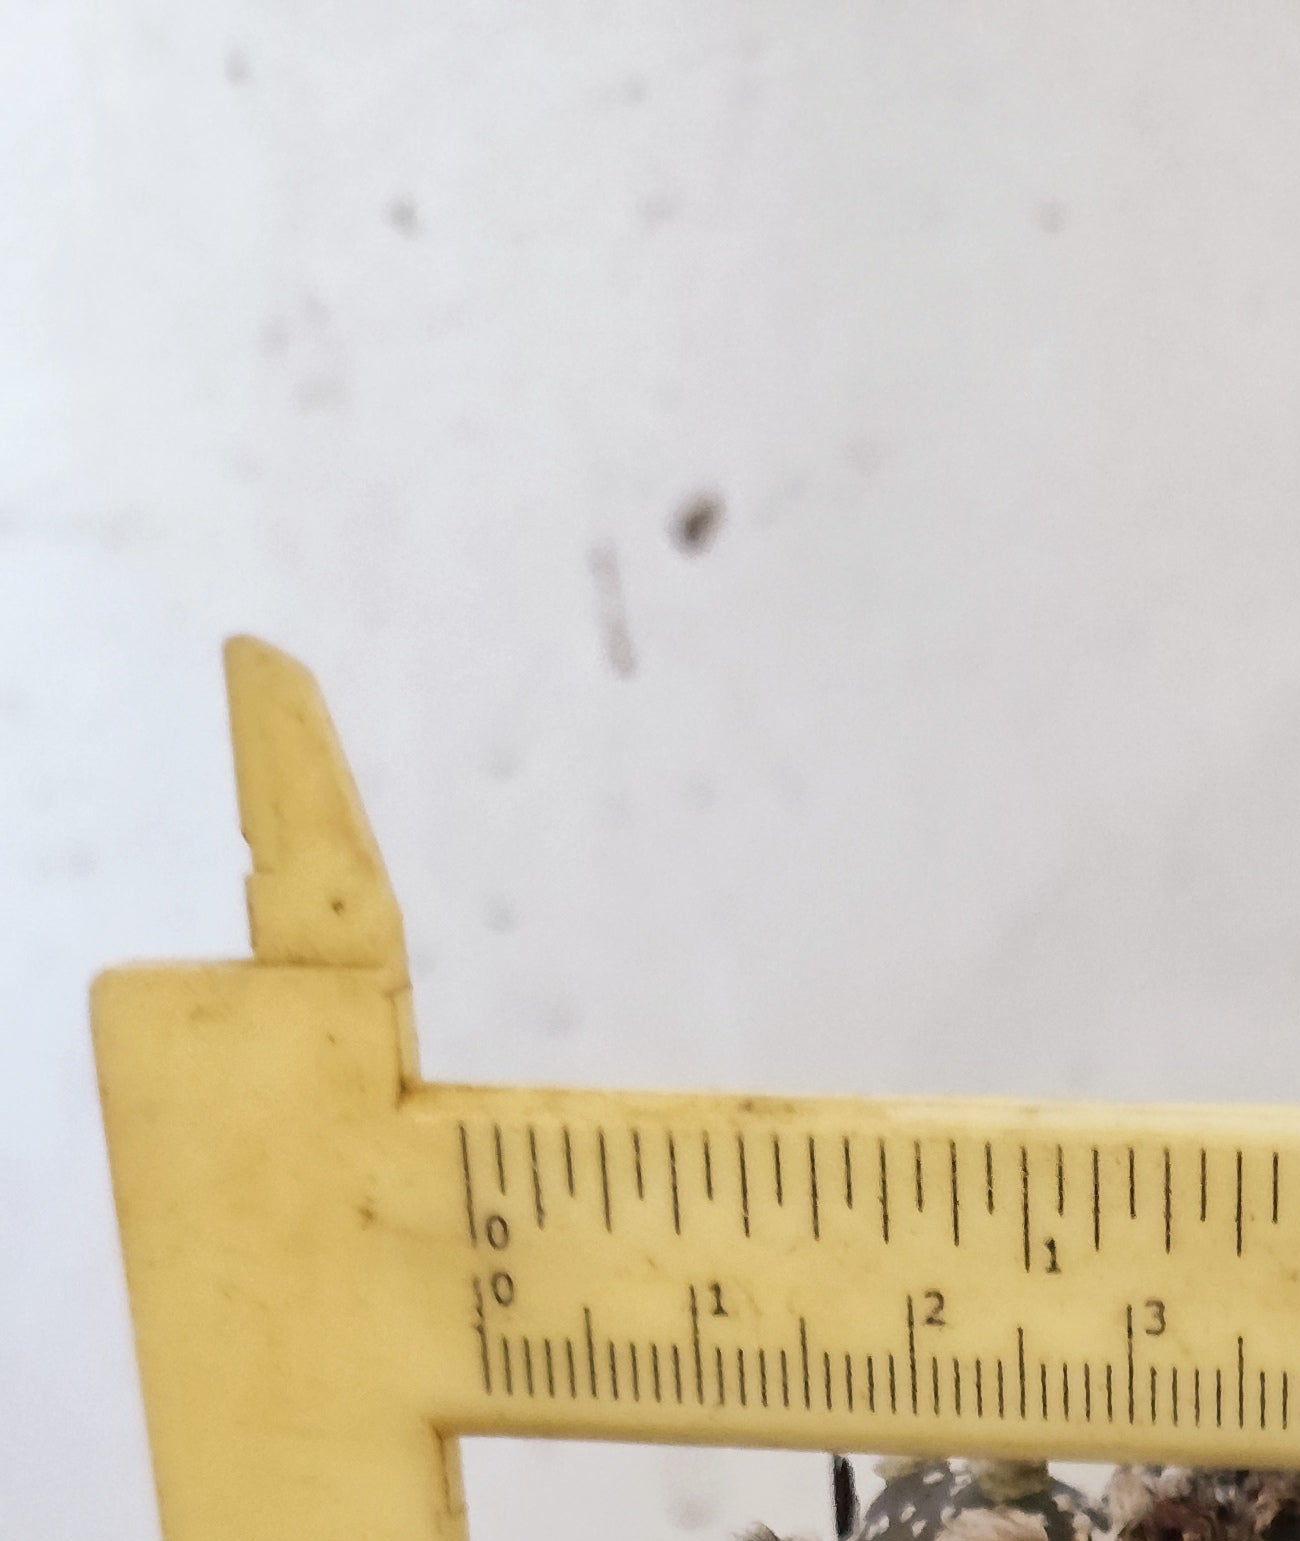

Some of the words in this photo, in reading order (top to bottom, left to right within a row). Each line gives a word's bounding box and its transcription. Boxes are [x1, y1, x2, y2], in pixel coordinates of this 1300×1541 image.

[487, 1215, 511, 1250] 0
[1044, 1237, 1061, 1273] 1
[491, 1271, 515, 1306] 0
[709, 1282, 728, 1317] 1
[924, 1292, 946, 1326] 2
[1144, 1301, 1167, 1335] 3
